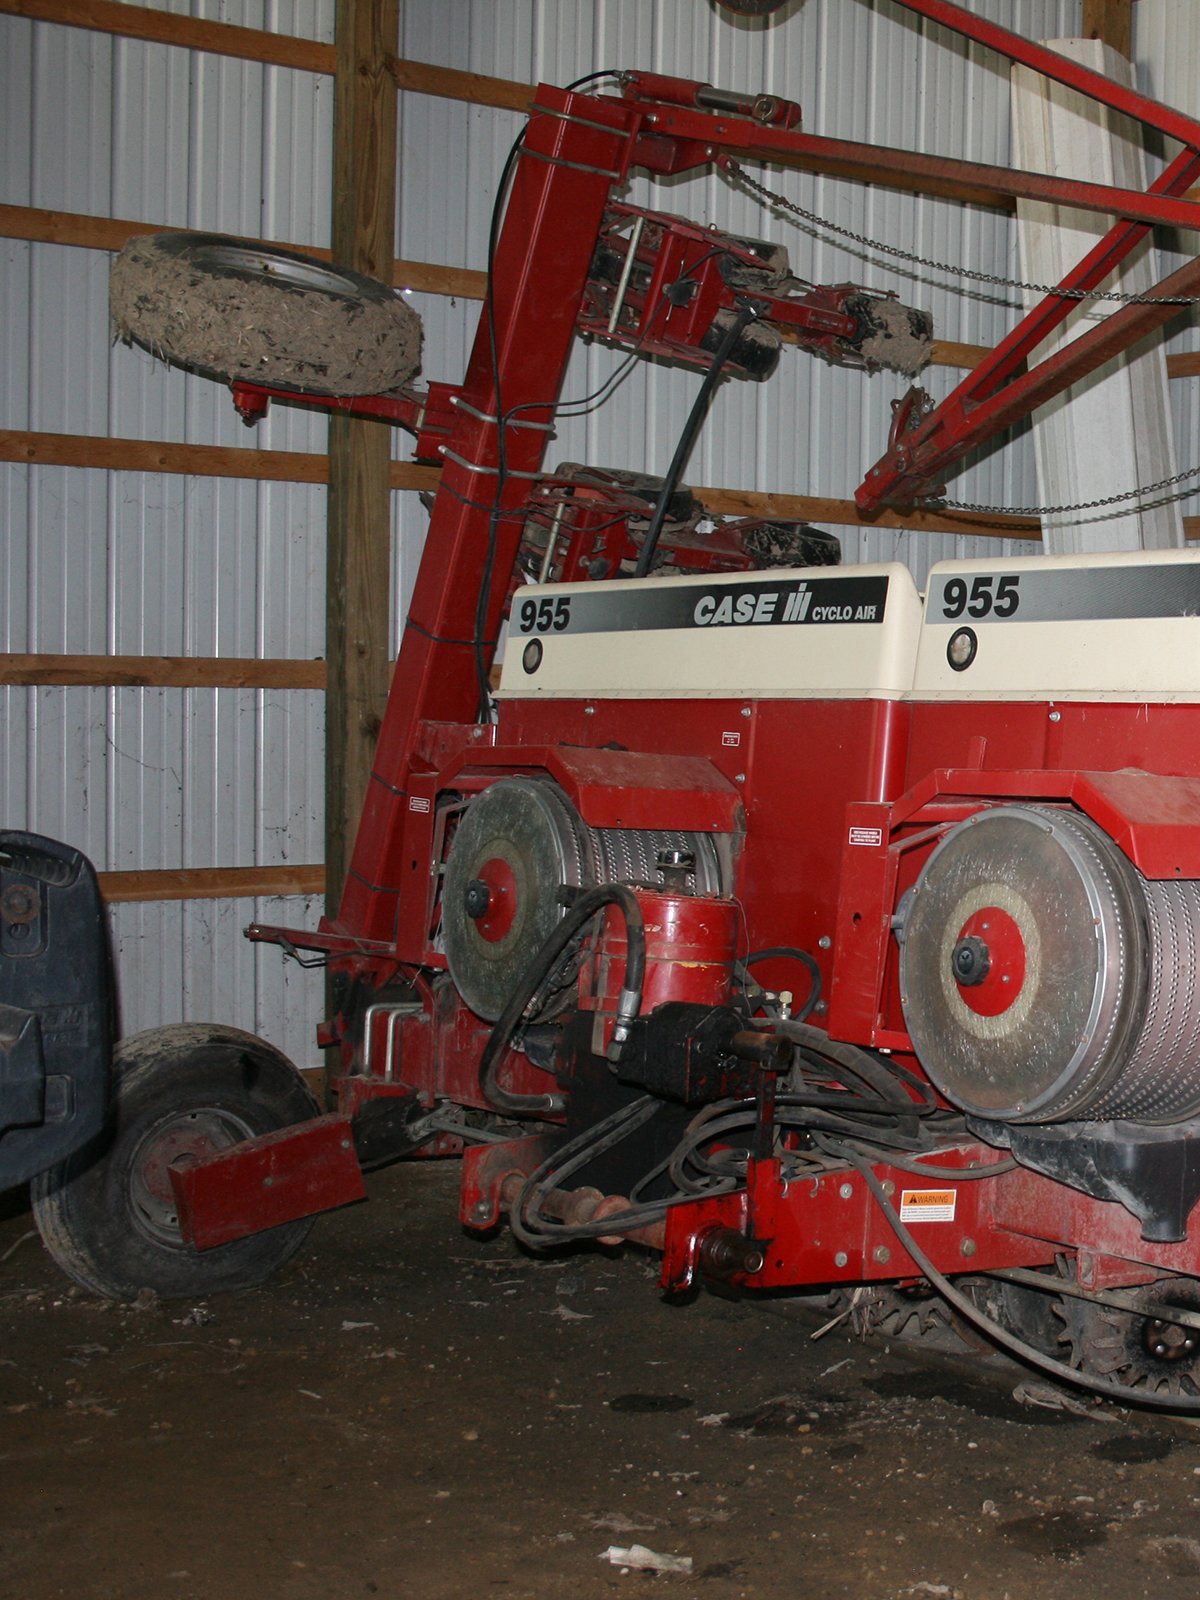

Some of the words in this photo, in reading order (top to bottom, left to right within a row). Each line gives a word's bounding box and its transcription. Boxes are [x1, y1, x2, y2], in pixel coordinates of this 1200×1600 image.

[693, 593, 778, 626] CASE
[812, 606, 852, 621] CYCLO
[854, 604, 877, 620] AIR
[942, 576, 1019, 619] 955
[519, 597, 571, 633] 955
[918, 1195, 949, 1204] WARNING
